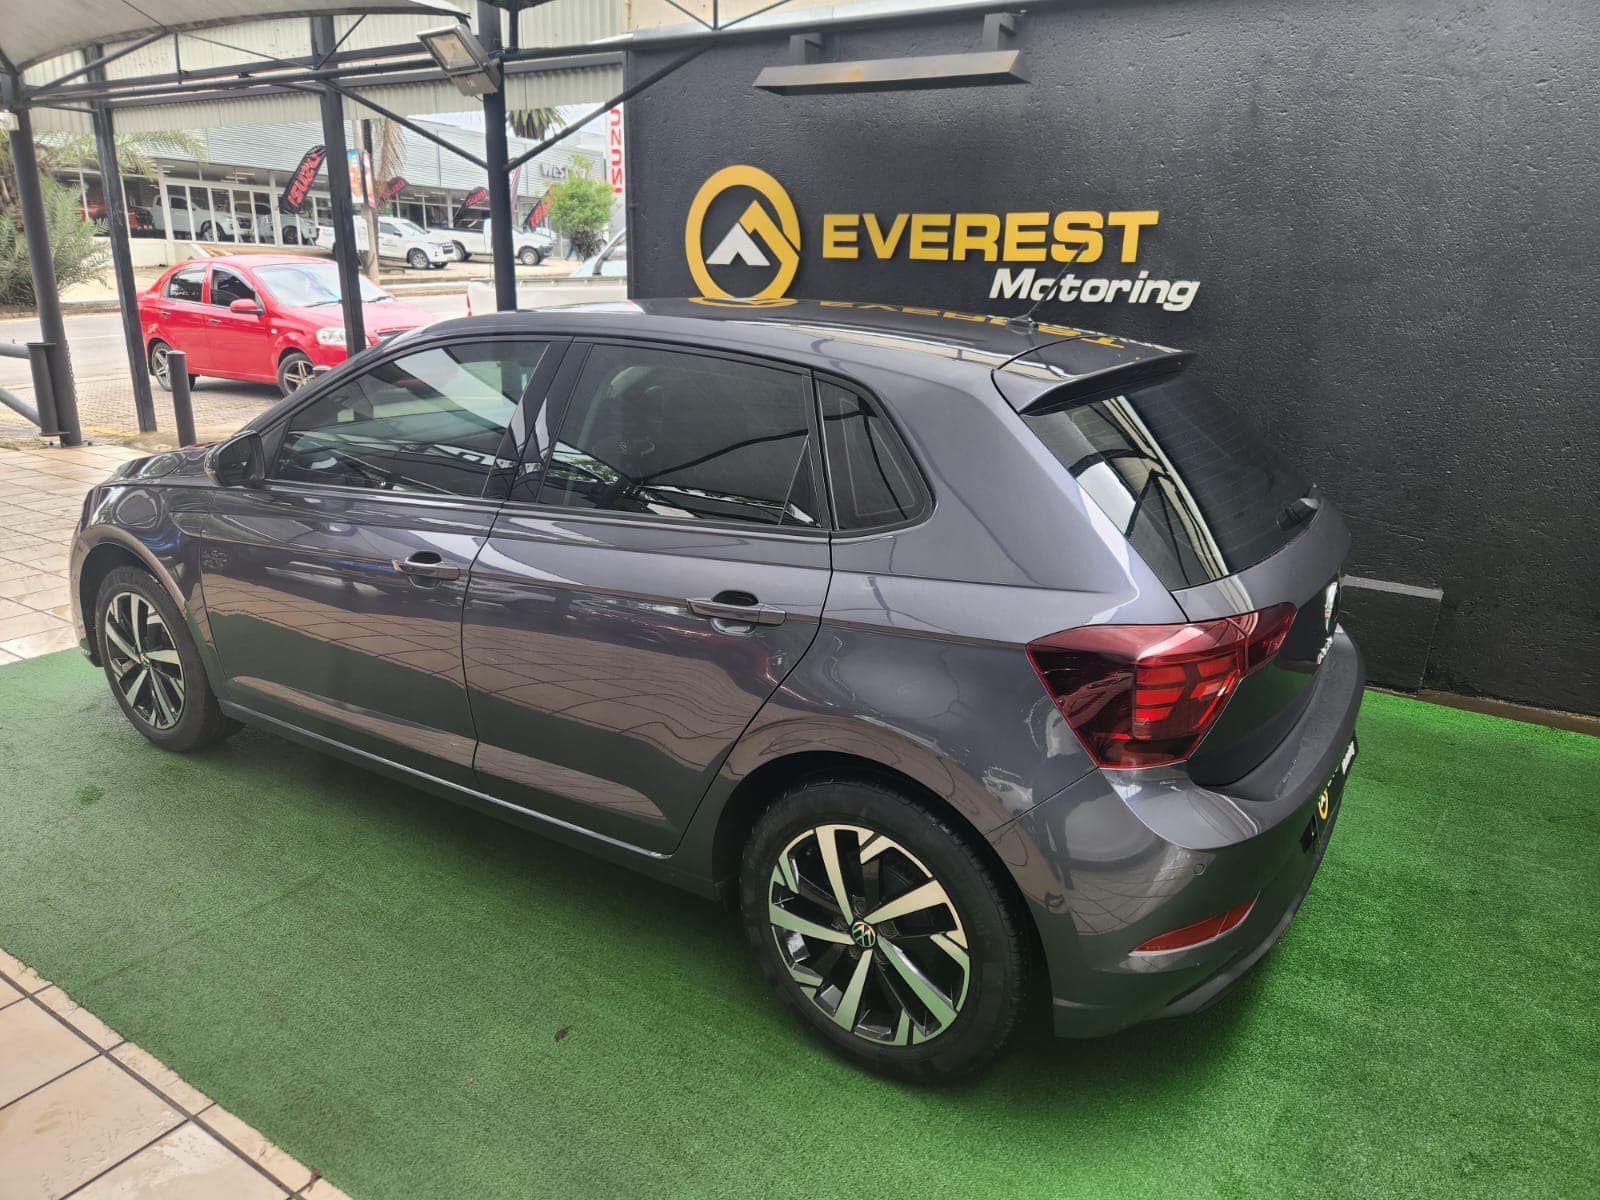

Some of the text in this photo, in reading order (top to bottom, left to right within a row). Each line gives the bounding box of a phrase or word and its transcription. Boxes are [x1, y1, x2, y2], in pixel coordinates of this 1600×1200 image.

[609, 107, 623, 193] ISUZU
[288, 152, 321, 208] ISUZU
[822, 210, 1160, 264] EVEREST
[988, 267, 1201, 313] Motoring
